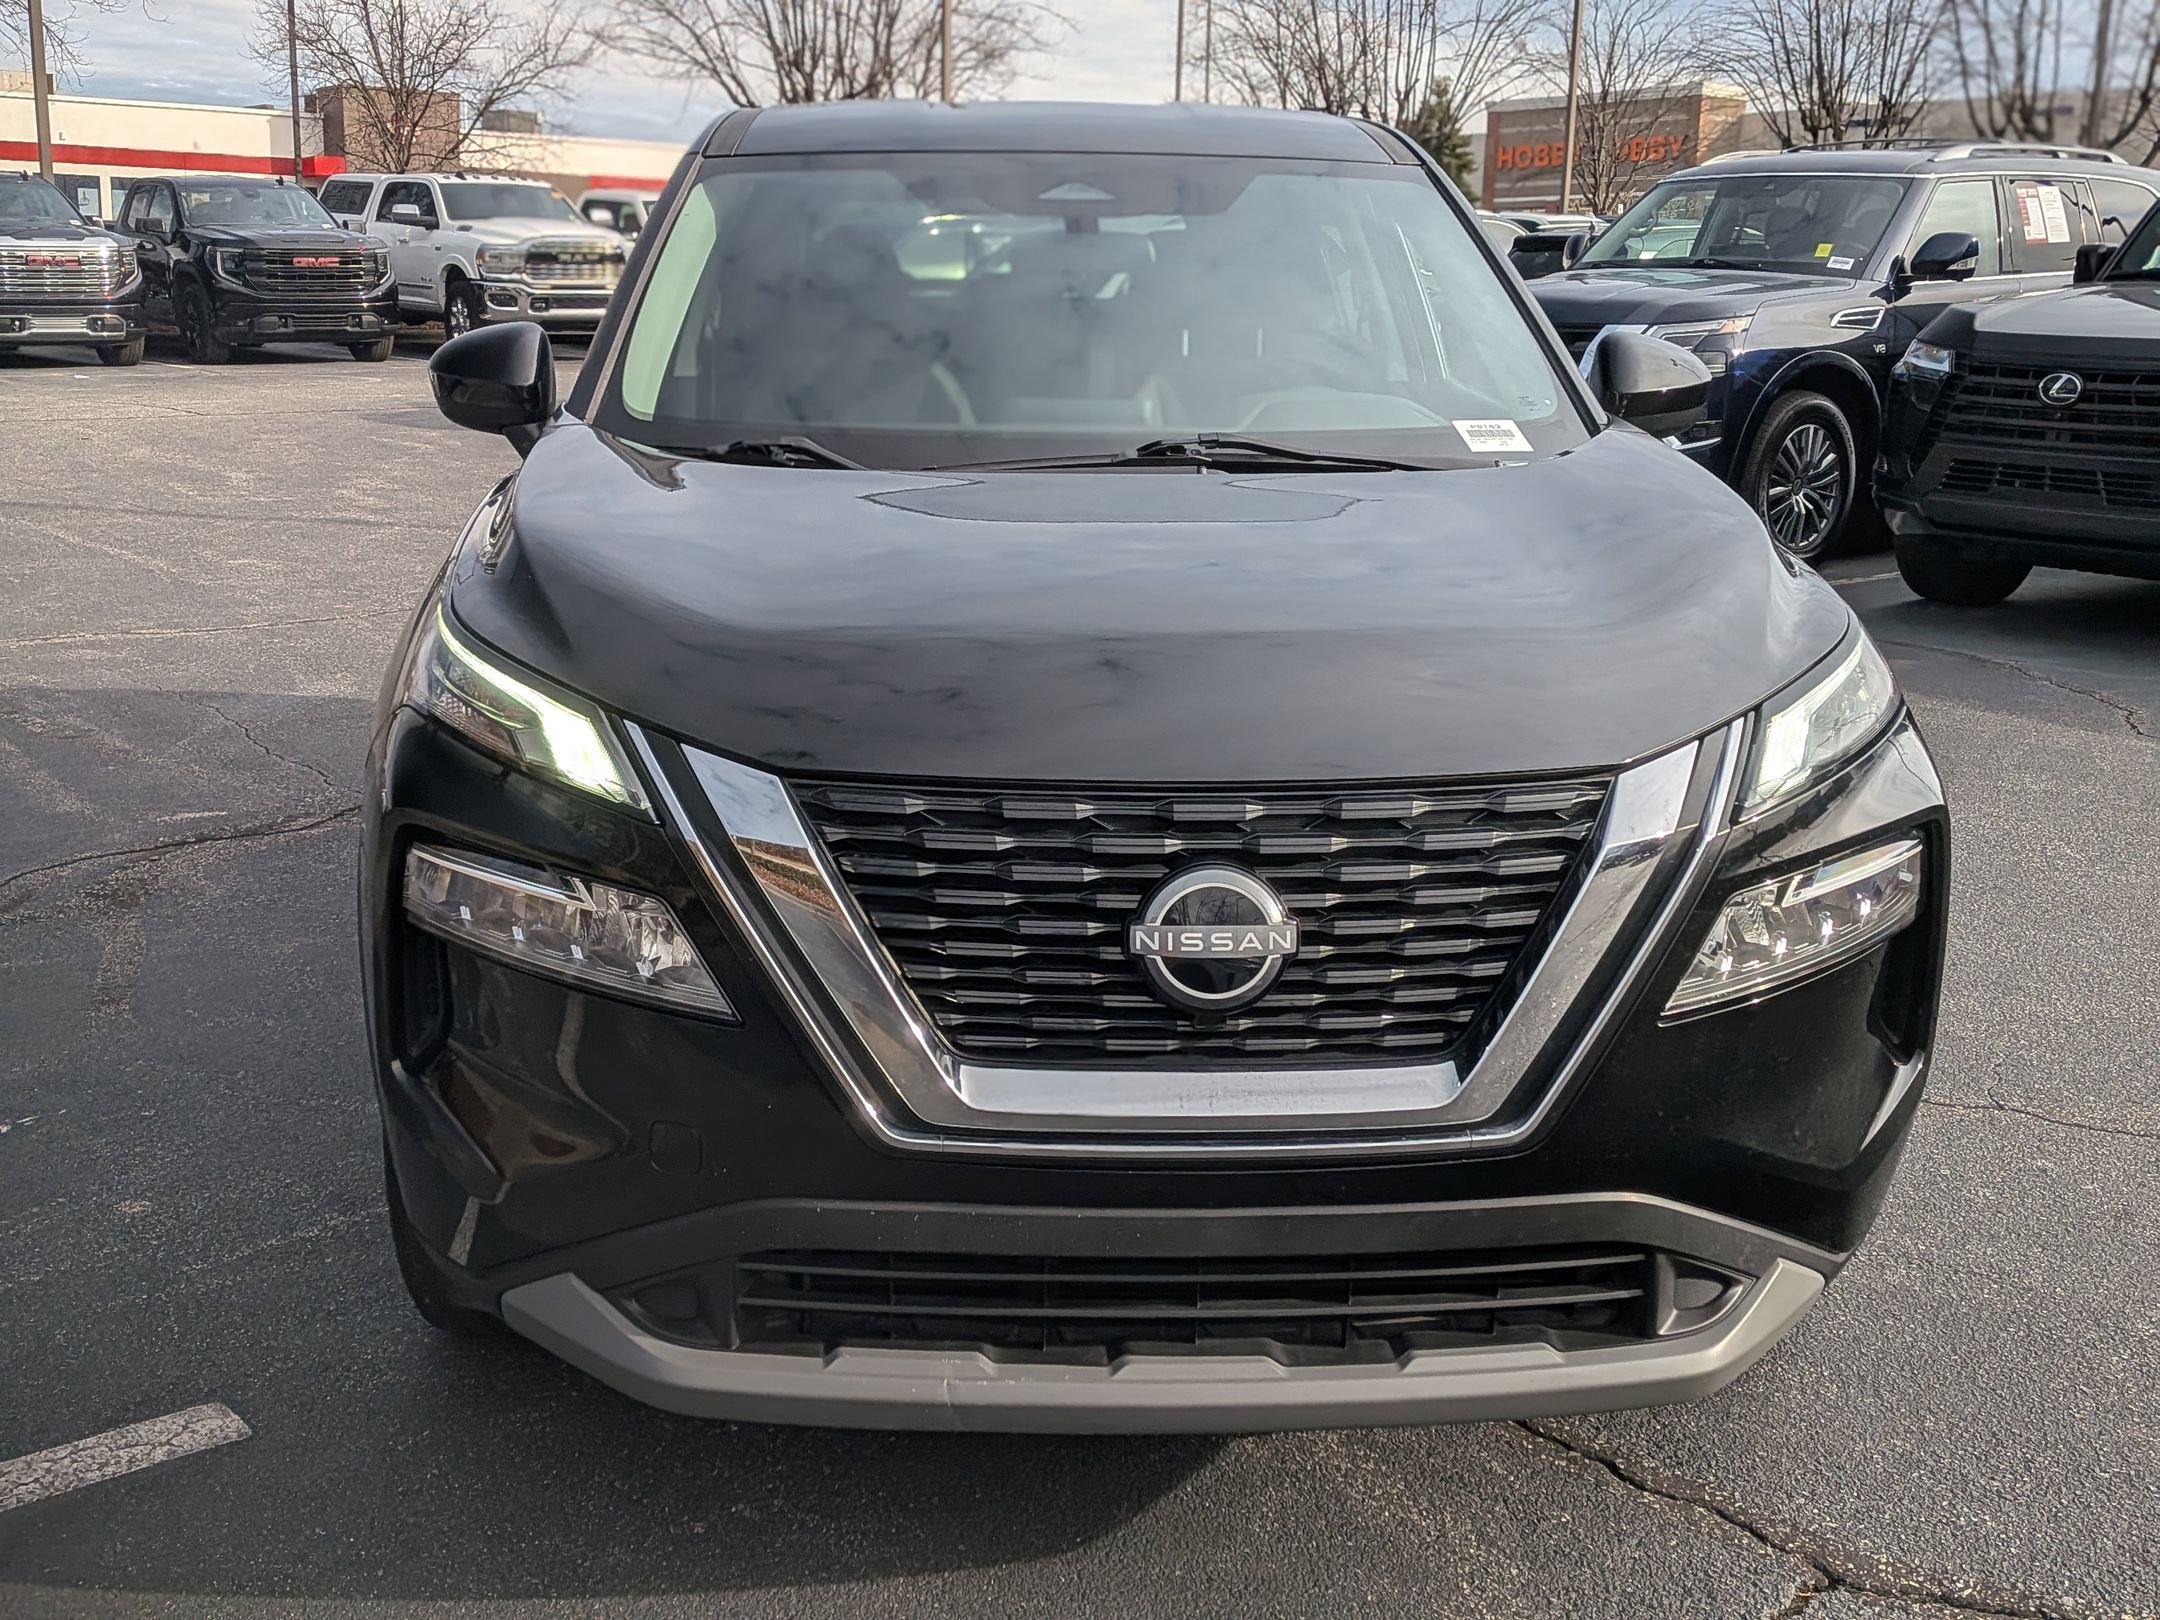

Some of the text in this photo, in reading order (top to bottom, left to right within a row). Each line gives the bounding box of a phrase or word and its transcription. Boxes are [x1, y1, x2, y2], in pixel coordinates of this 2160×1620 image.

[1497, 139, 1583, 169] HOBB
[27, 255, 80, 266] GMC
[293, 256, 340, 267] GMC
[1134, 930, 1292, 952] NISSAN
